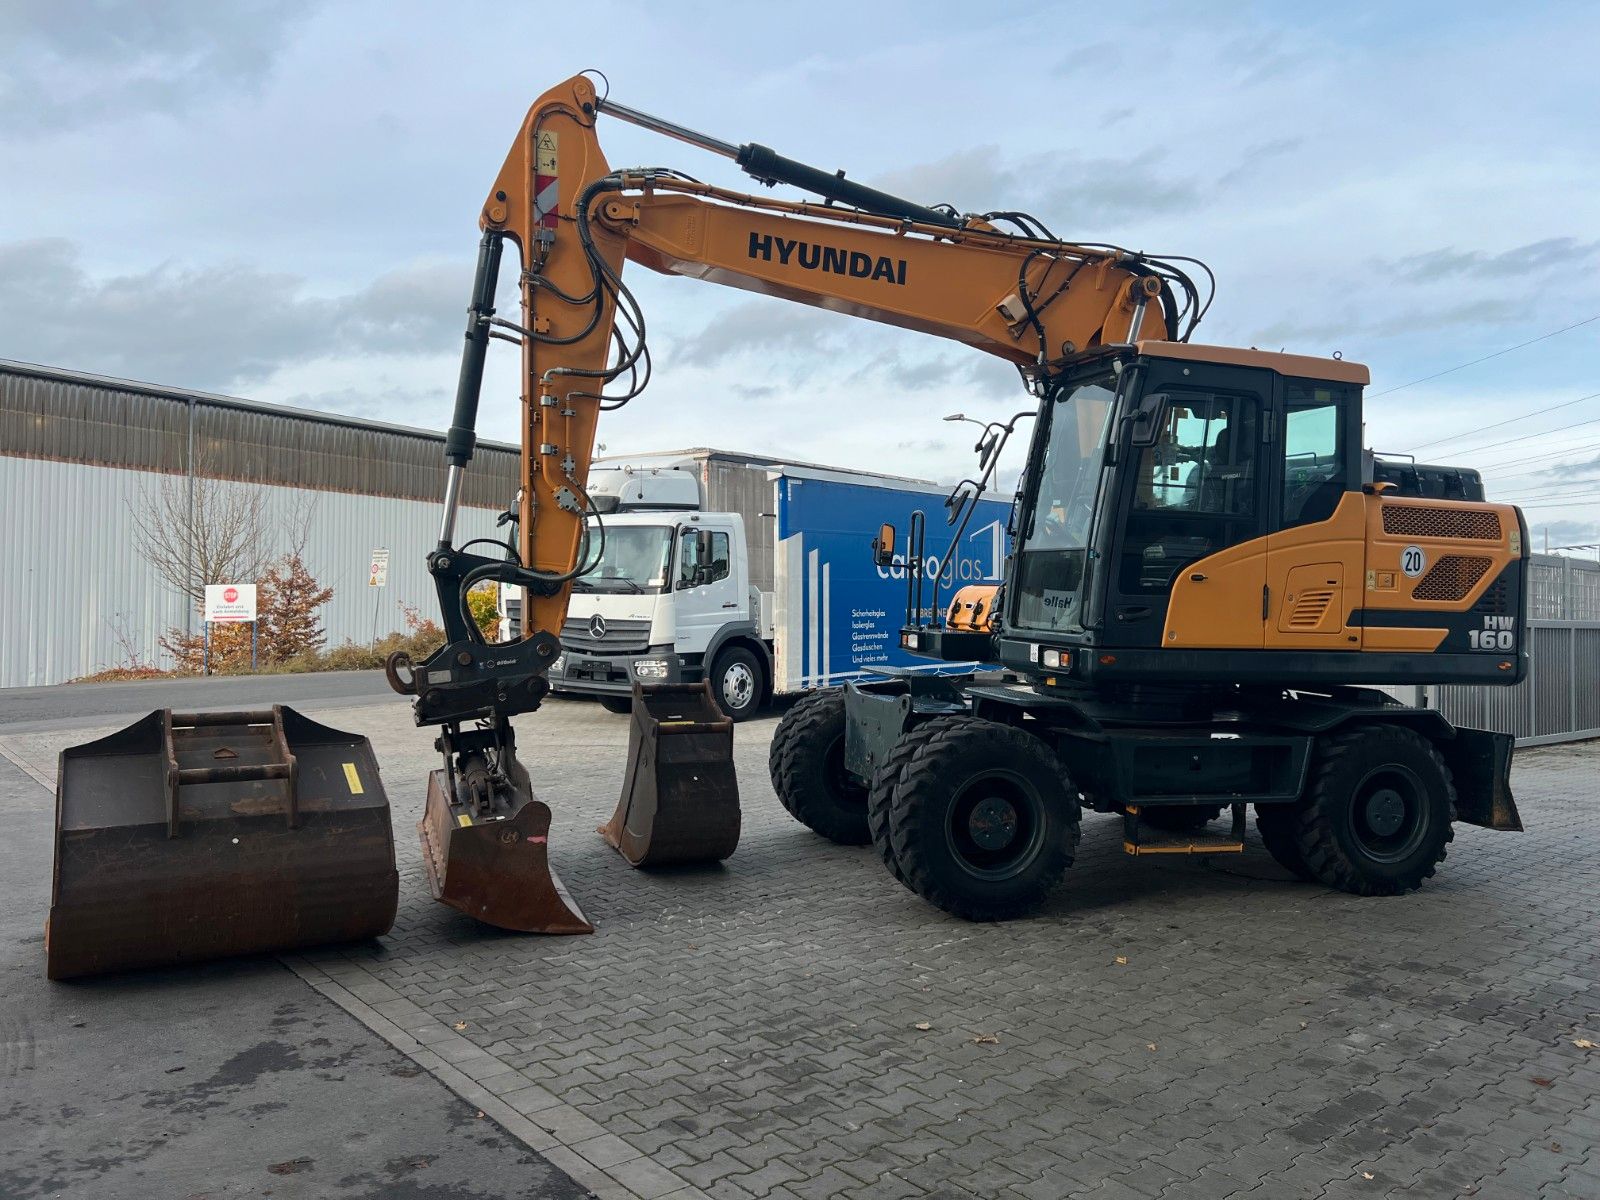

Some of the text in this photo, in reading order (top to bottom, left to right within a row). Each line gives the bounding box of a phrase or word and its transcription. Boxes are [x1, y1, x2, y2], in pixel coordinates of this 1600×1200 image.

[748, 232, 907, 285] HYUNDAI
[1405, 552, 1421, 572] 20
[851, 608, 886, 618] Sicherheitsglas
[851, 620, 875, 630] Isolierglas
[1484, 615, 1514, 630] HW
[851, 630, 889, 640] Glastrennwände
[1468, 629, 1514, 651] 160
[851, 642, 883, 652] Glasduschen
[852, 654, 863, 663] Und
